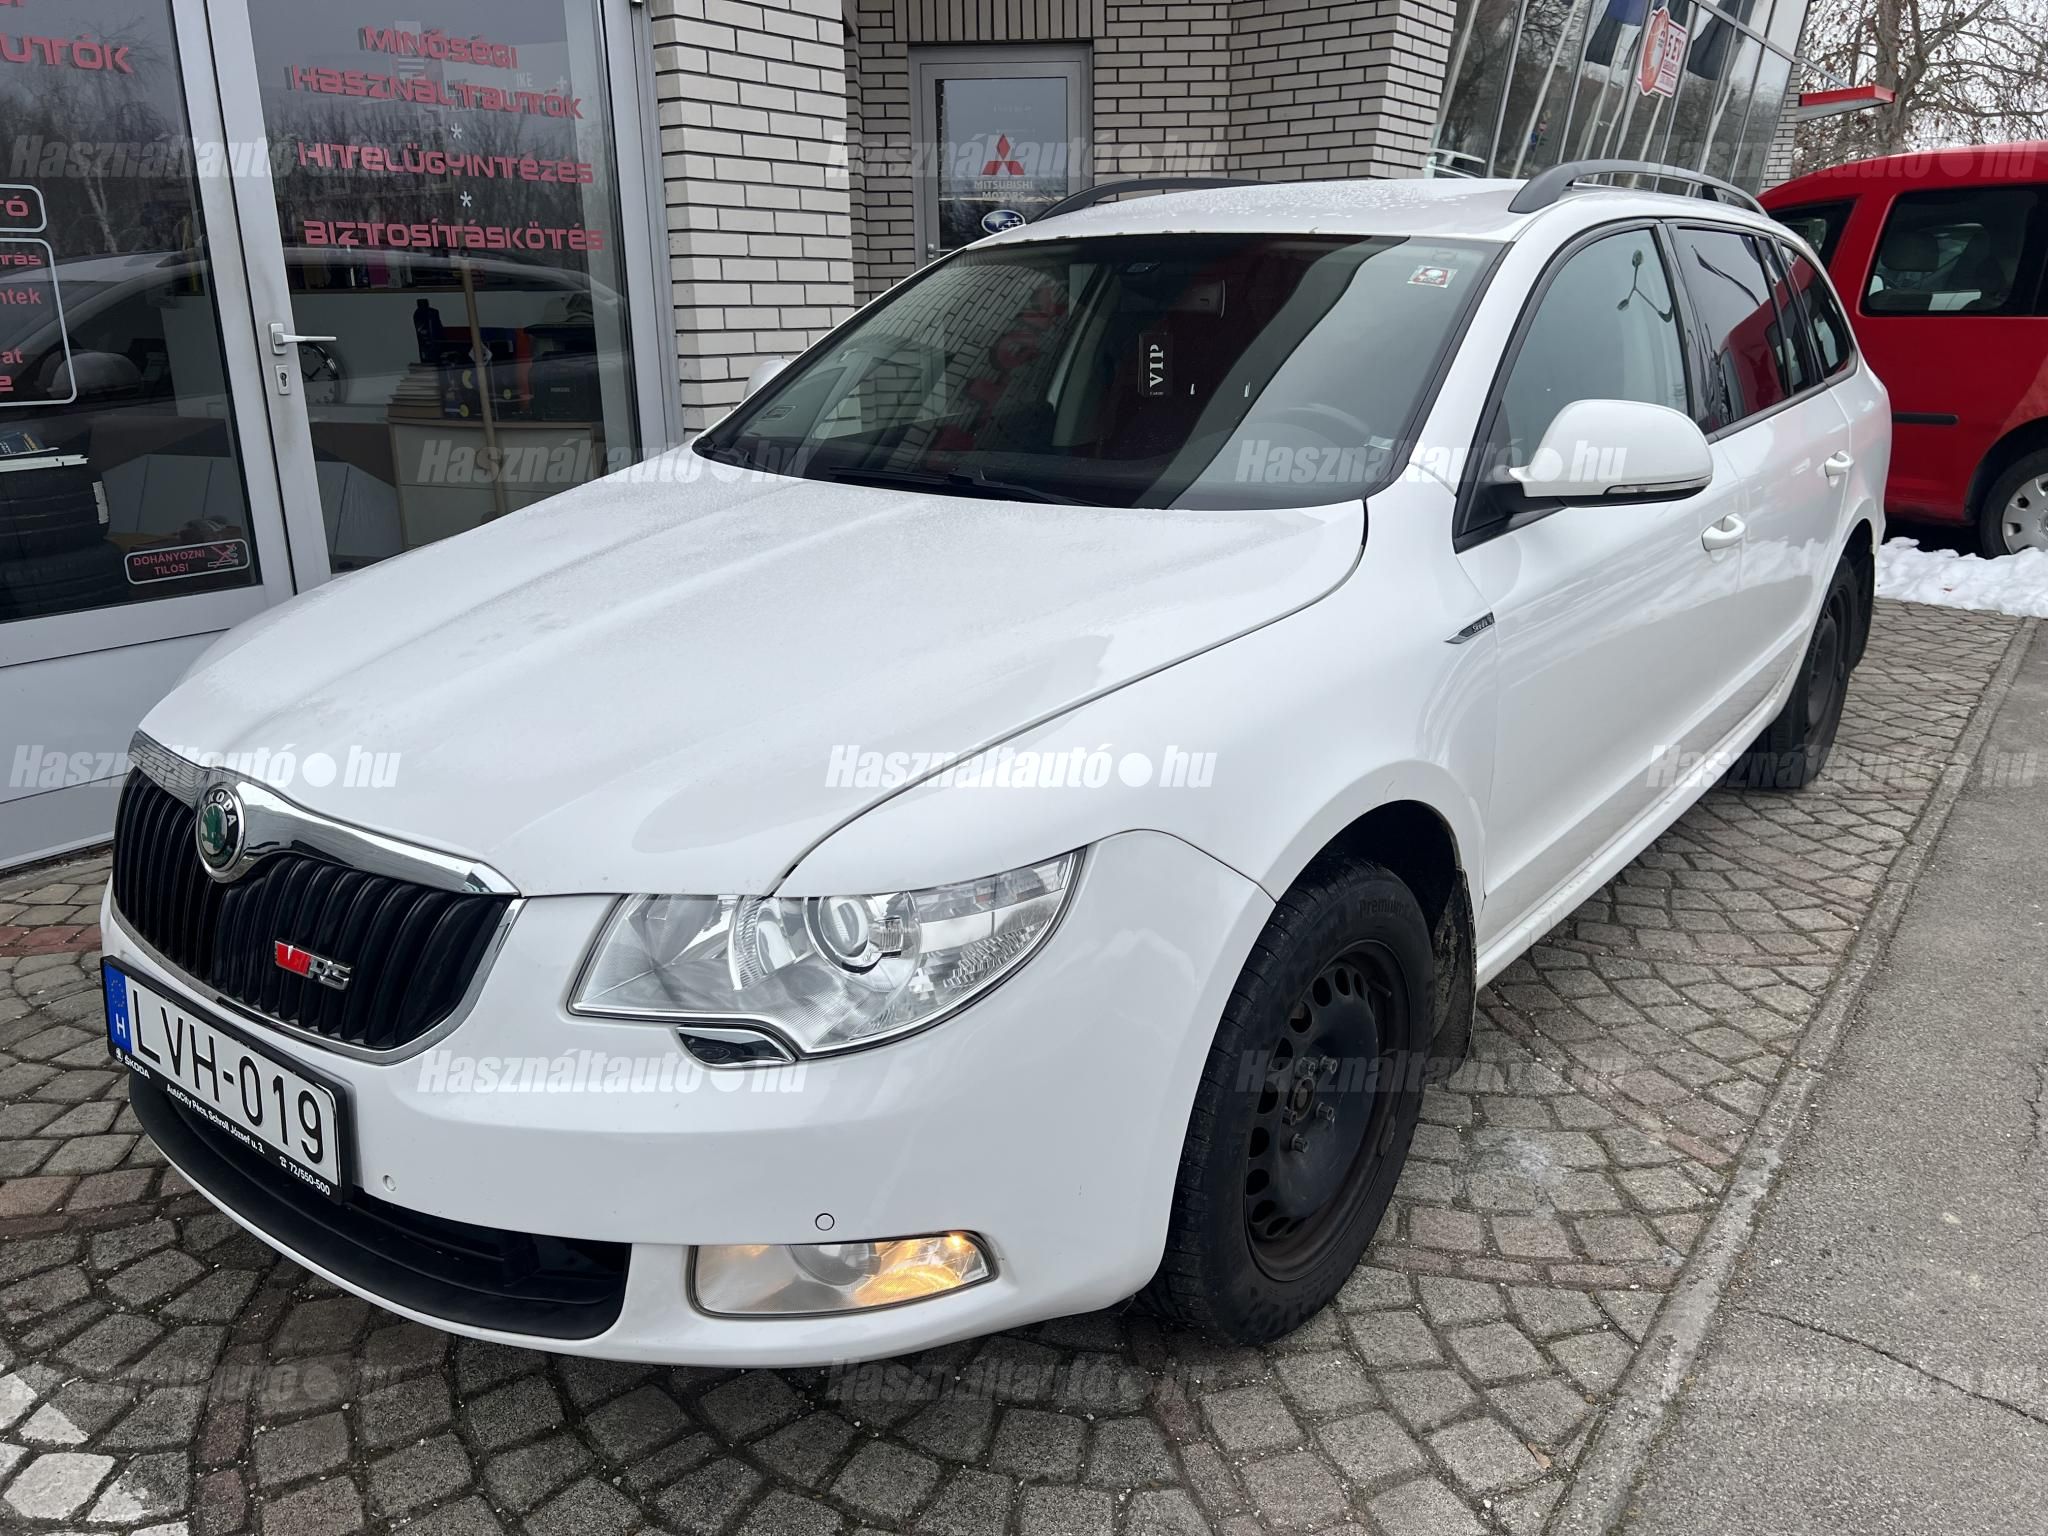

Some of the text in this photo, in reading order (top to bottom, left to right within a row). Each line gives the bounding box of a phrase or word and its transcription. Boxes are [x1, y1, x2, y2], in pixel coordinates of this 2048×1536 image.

[974, 180, 1033, 189] MITSUBISHI
[982, 191, 1025, 201] MOTORS
[1149, 344, 1164, 389] VIP
[115, 1012, 127, 1039] H
[132, 988, 324, 1165] LVH-019
